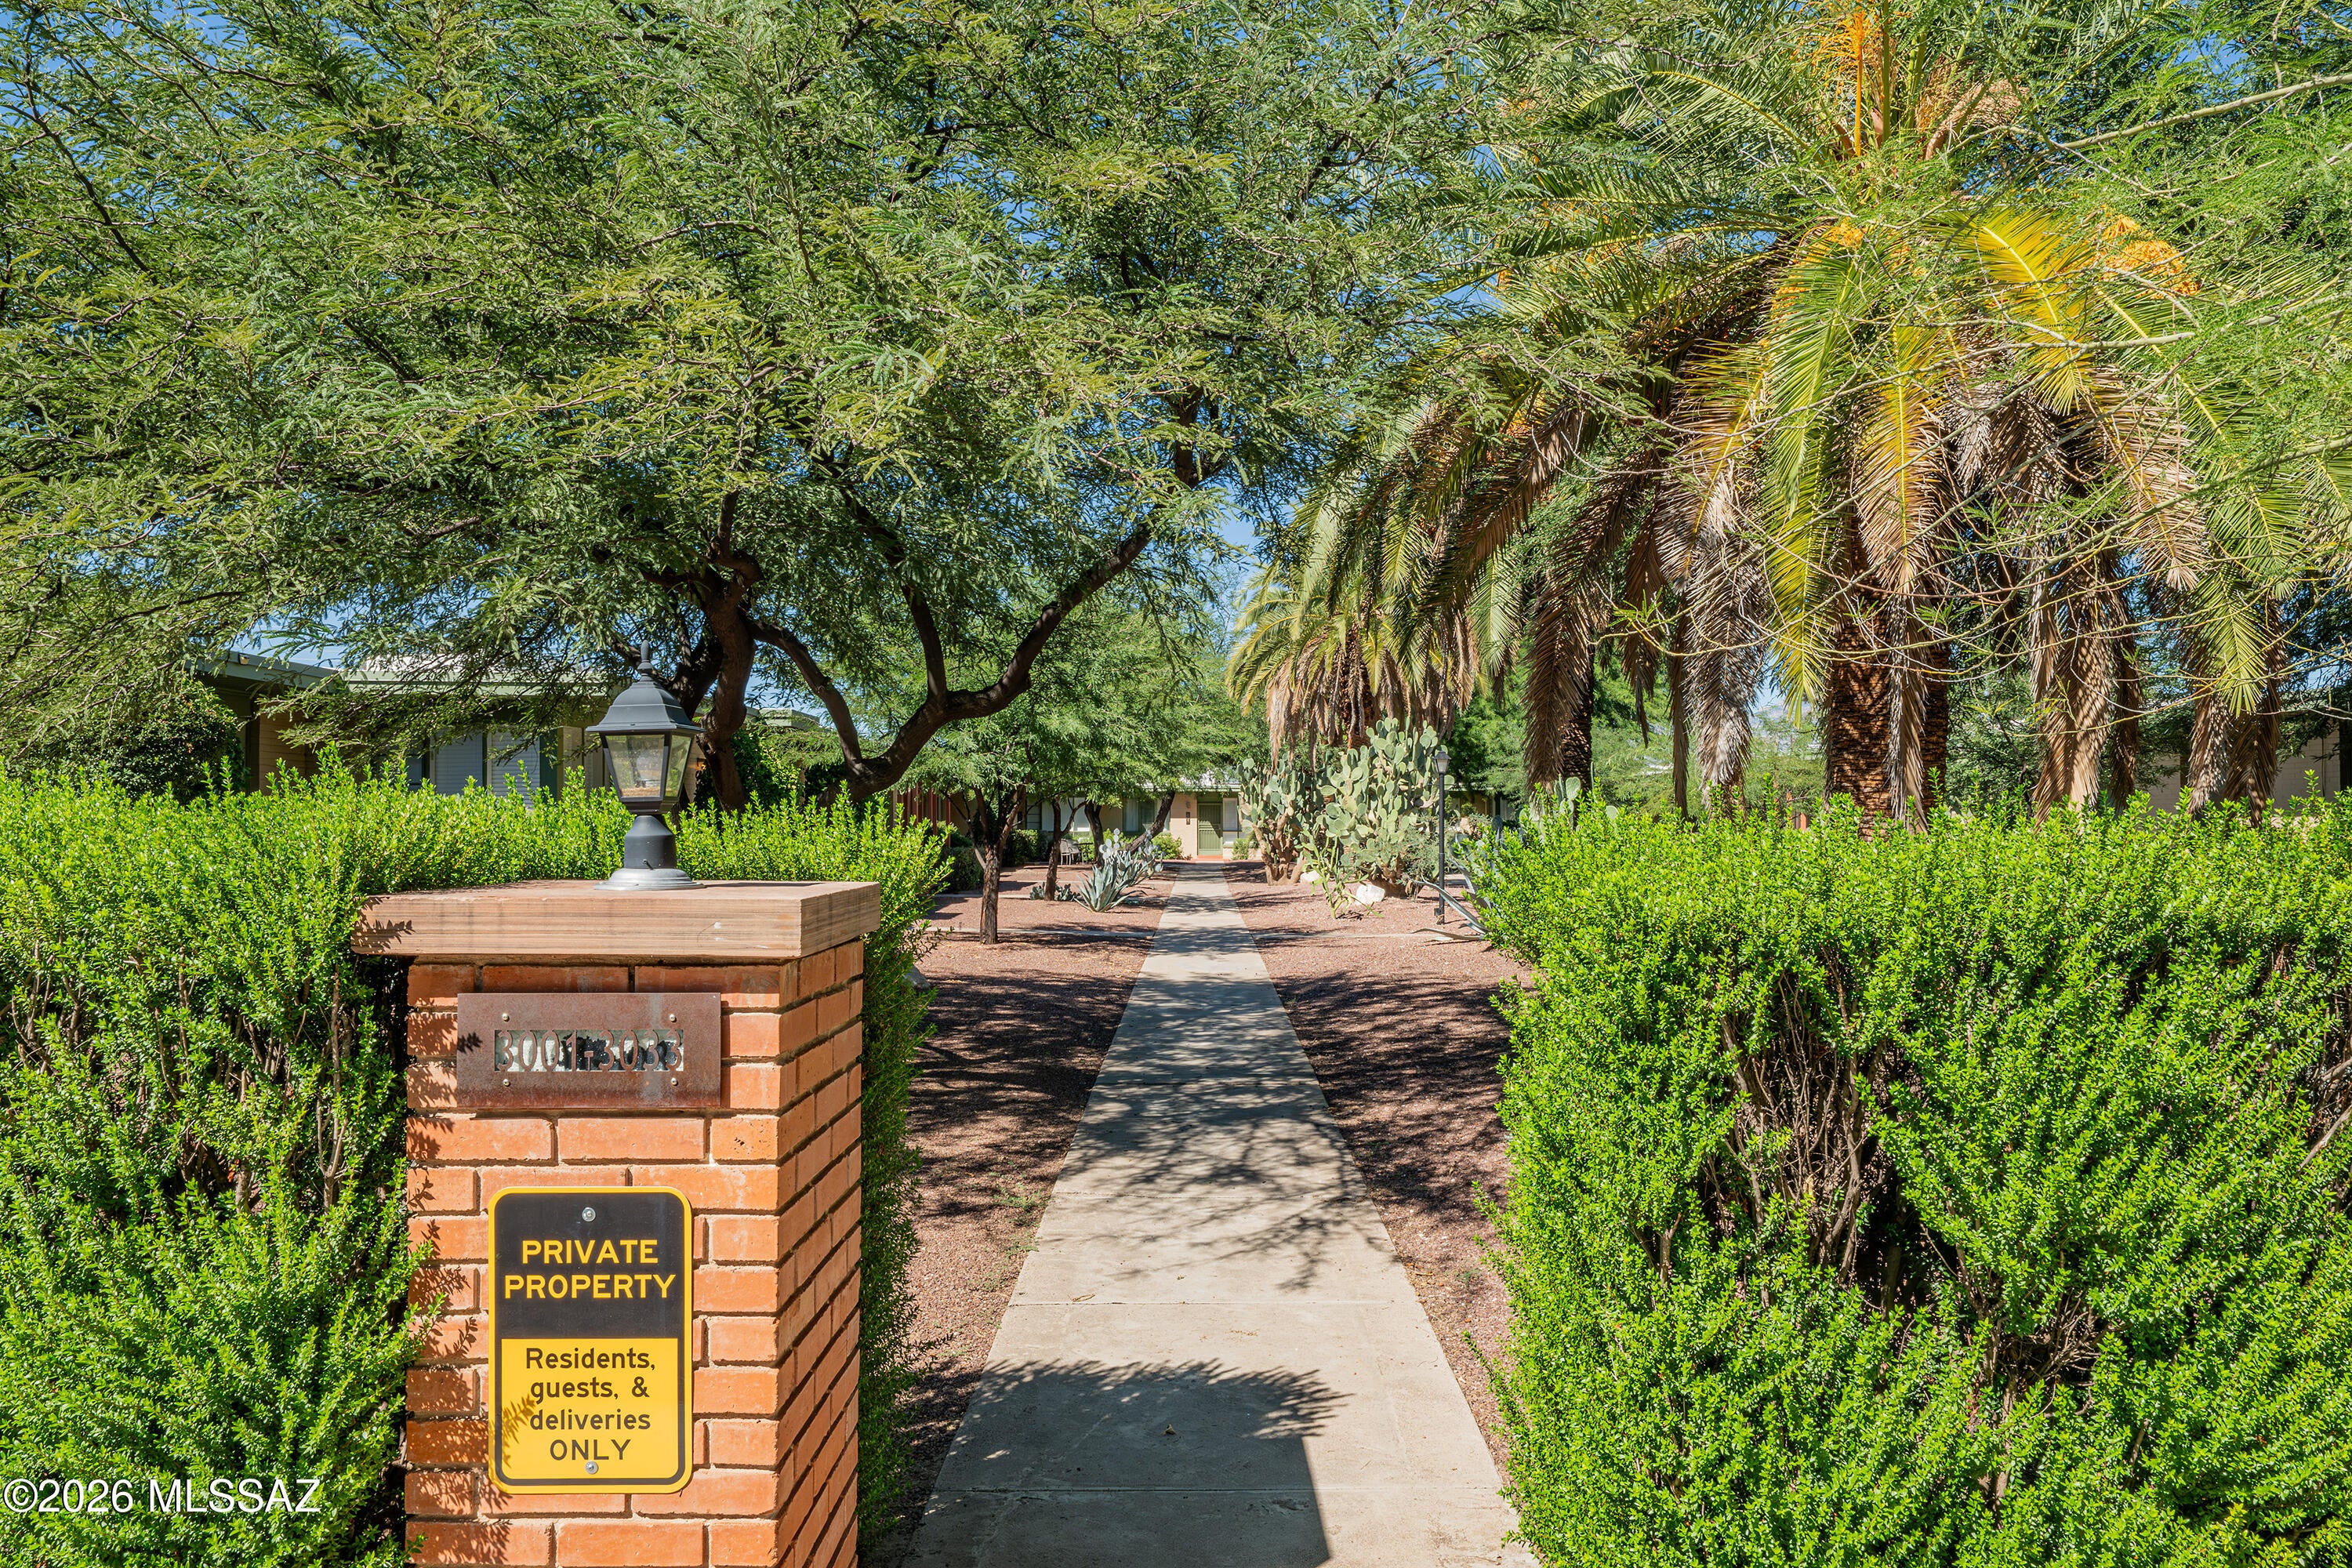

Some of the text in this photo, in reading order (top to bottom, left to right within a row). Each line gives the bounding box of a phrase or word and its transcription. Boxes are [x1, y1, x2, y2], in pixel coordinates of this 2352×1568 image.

[498, 1030, 681, 1071] 3001-3033
[522, 1240, 658, 1263] PRIVATE
[505, 1274, 676, 1298] PROPERTY
[526, 1348, 655, 1370] Residents,
[530, 1377, 649, 1404] guests, &
[530, 1409, 650, 1430] deliveries
[550, 1439, 631, 1461] ONLY
